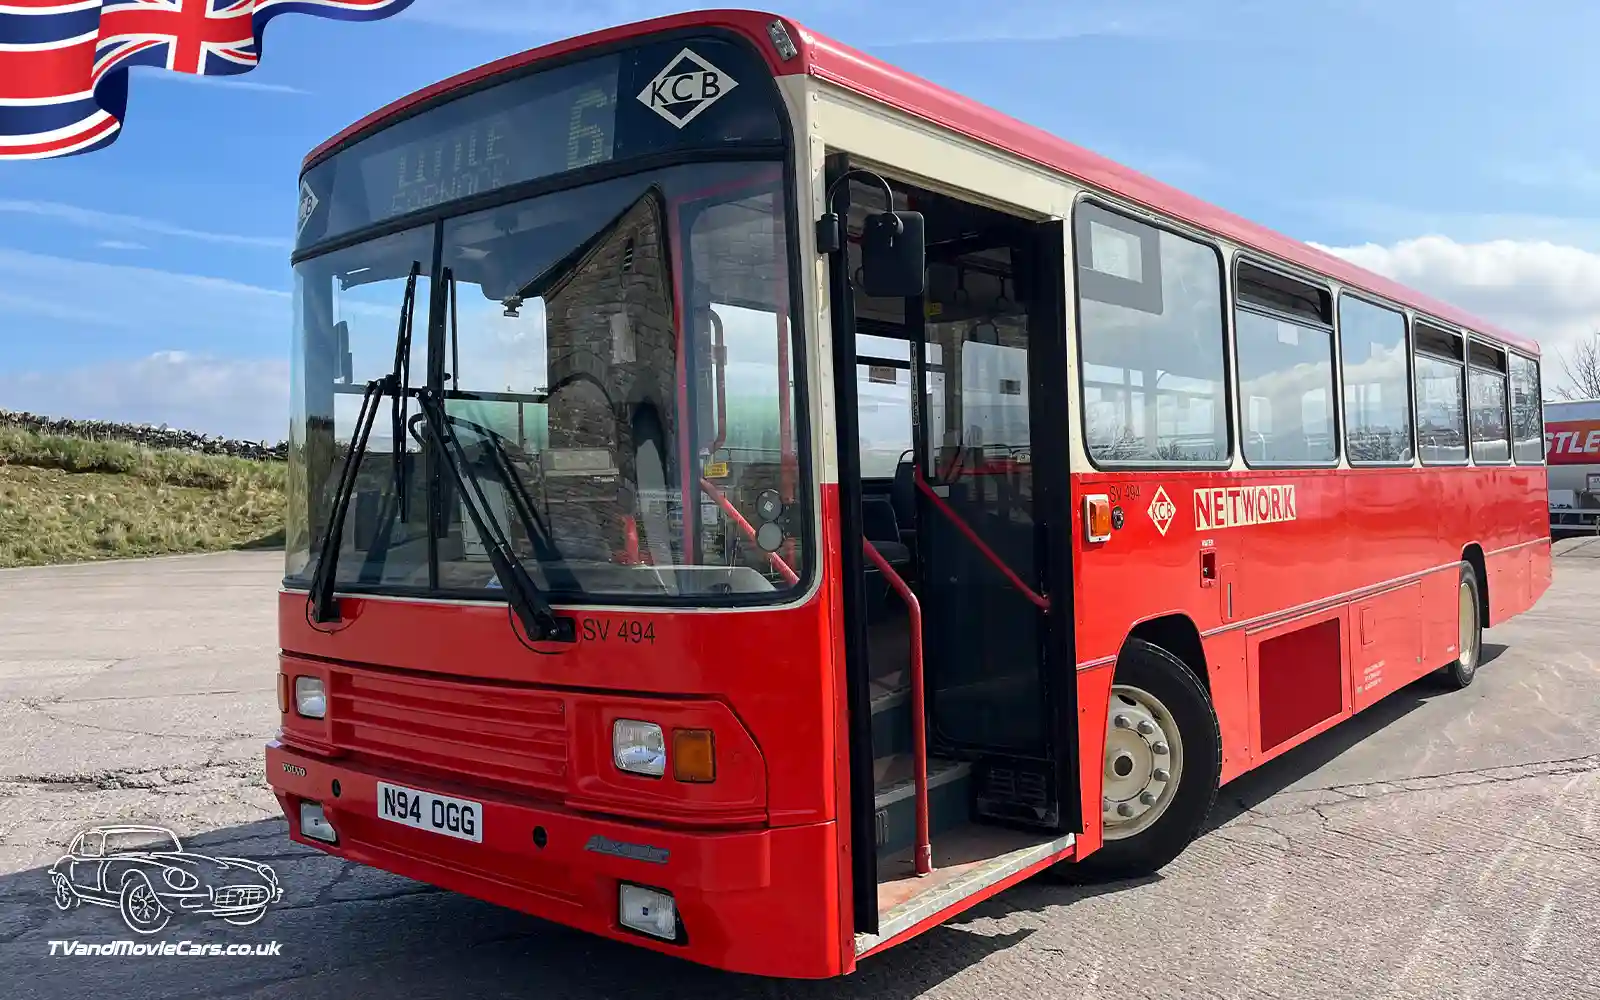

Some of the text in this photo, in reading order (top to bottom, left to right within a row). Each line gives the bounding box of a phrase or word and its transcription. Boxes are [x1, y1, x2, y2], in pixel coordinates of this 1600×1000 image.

[650, 71, 721, 107] KCB
[1109, 484, 1140, 503] SV 494
[1152, 502, 1173, 520] KCB
[1196, 487, 1295, 528] NETWORK
[582, 618, 656, 645] SV 494
[282, 762, 306, 777] VOLVO
[383, 787, 475, 836] N94 OGG
